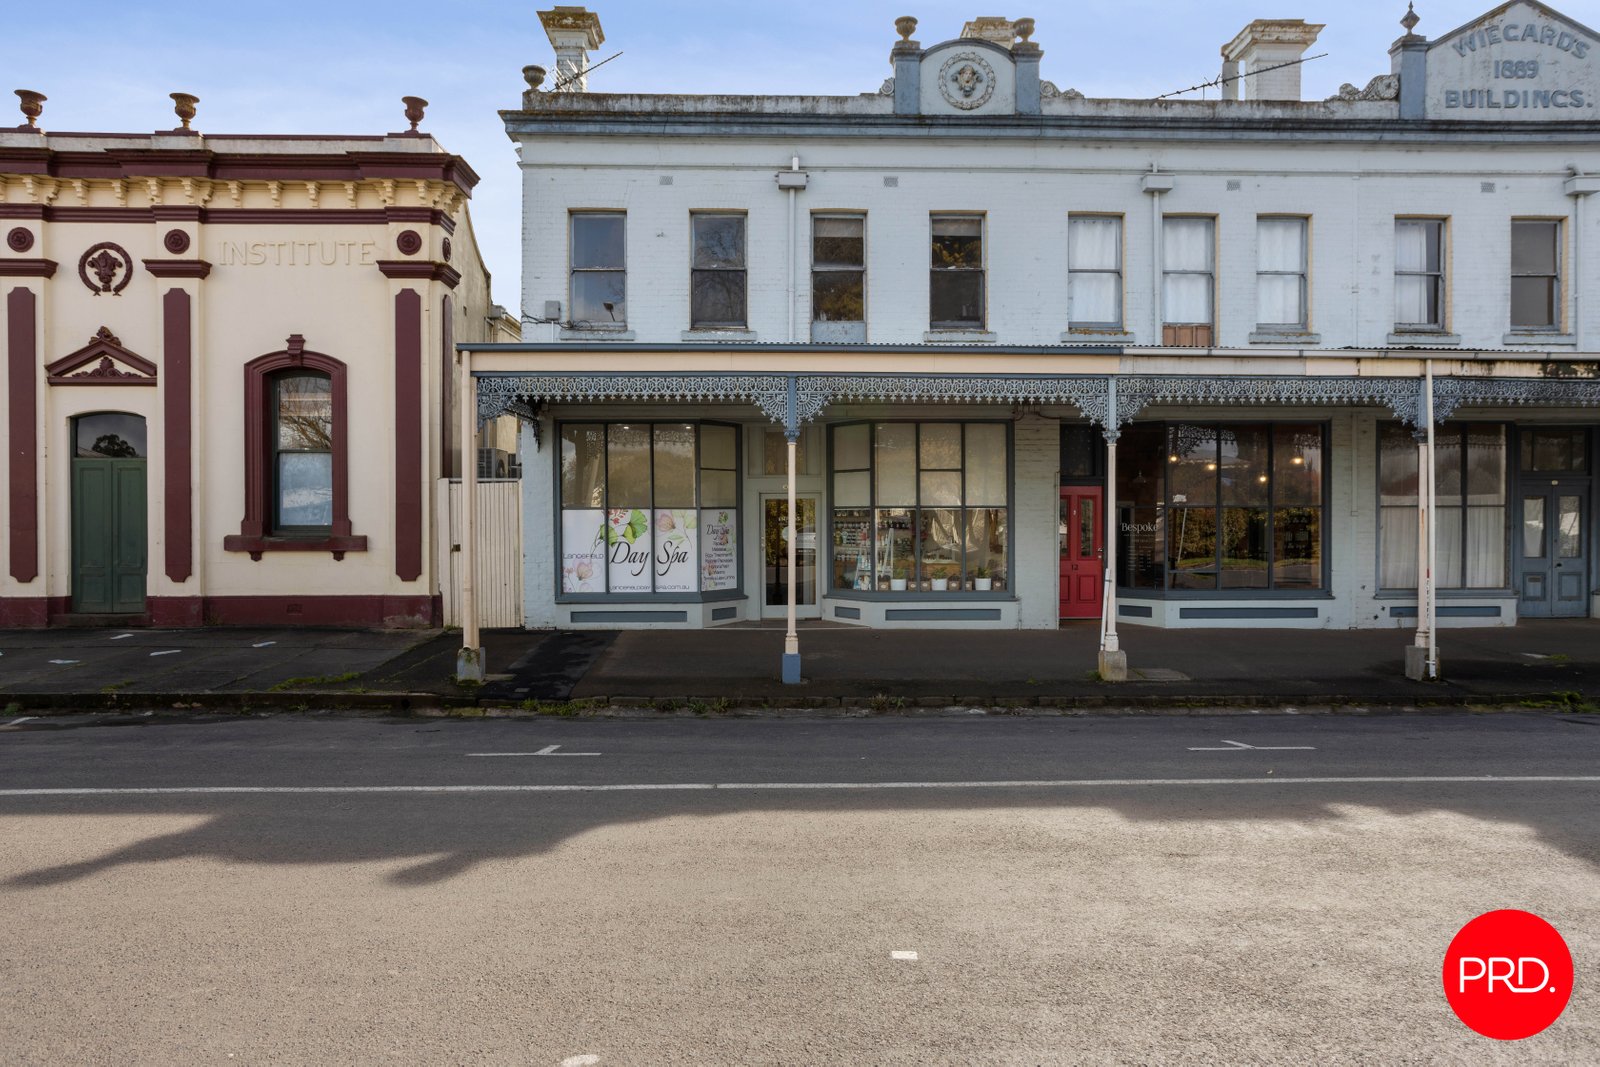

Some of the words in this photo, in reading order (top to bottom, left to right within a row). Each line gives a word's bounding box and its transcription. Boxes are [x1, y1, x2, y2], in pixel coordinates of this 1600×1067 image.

[1494, 60, 1539, 79] 1889
[219, 240, 377, 266] INSTITUTE
[1120, 522, 1158, 534] Bespoke
[609, 541, 651, 577] Day
[656, 540, 689, 577] Spa
